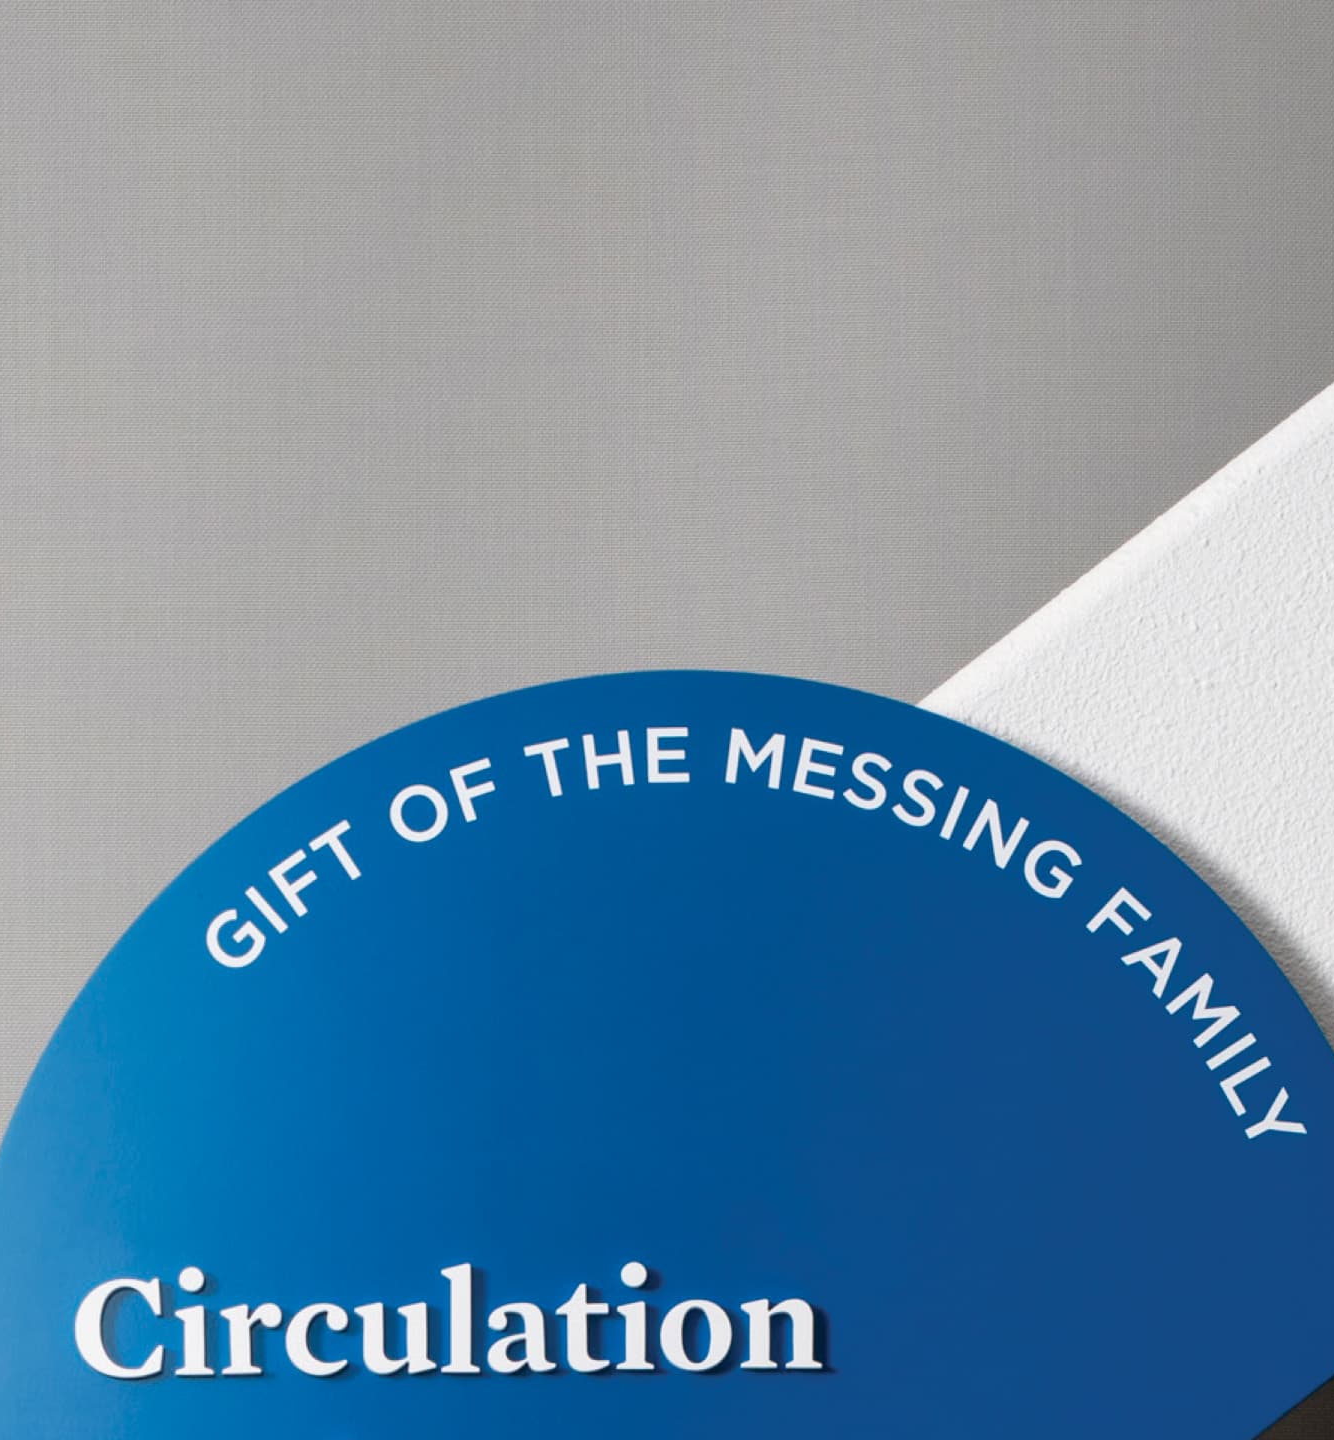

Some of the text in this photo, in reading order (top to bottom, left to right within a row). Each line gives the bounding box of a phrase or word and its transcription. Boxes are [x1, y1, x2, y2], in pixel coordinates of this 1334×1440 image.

[205, 725, 1308, 1149] GIFT OF THE MESSING FAMILY
[73, 1260, 825, 1379] Circulation
